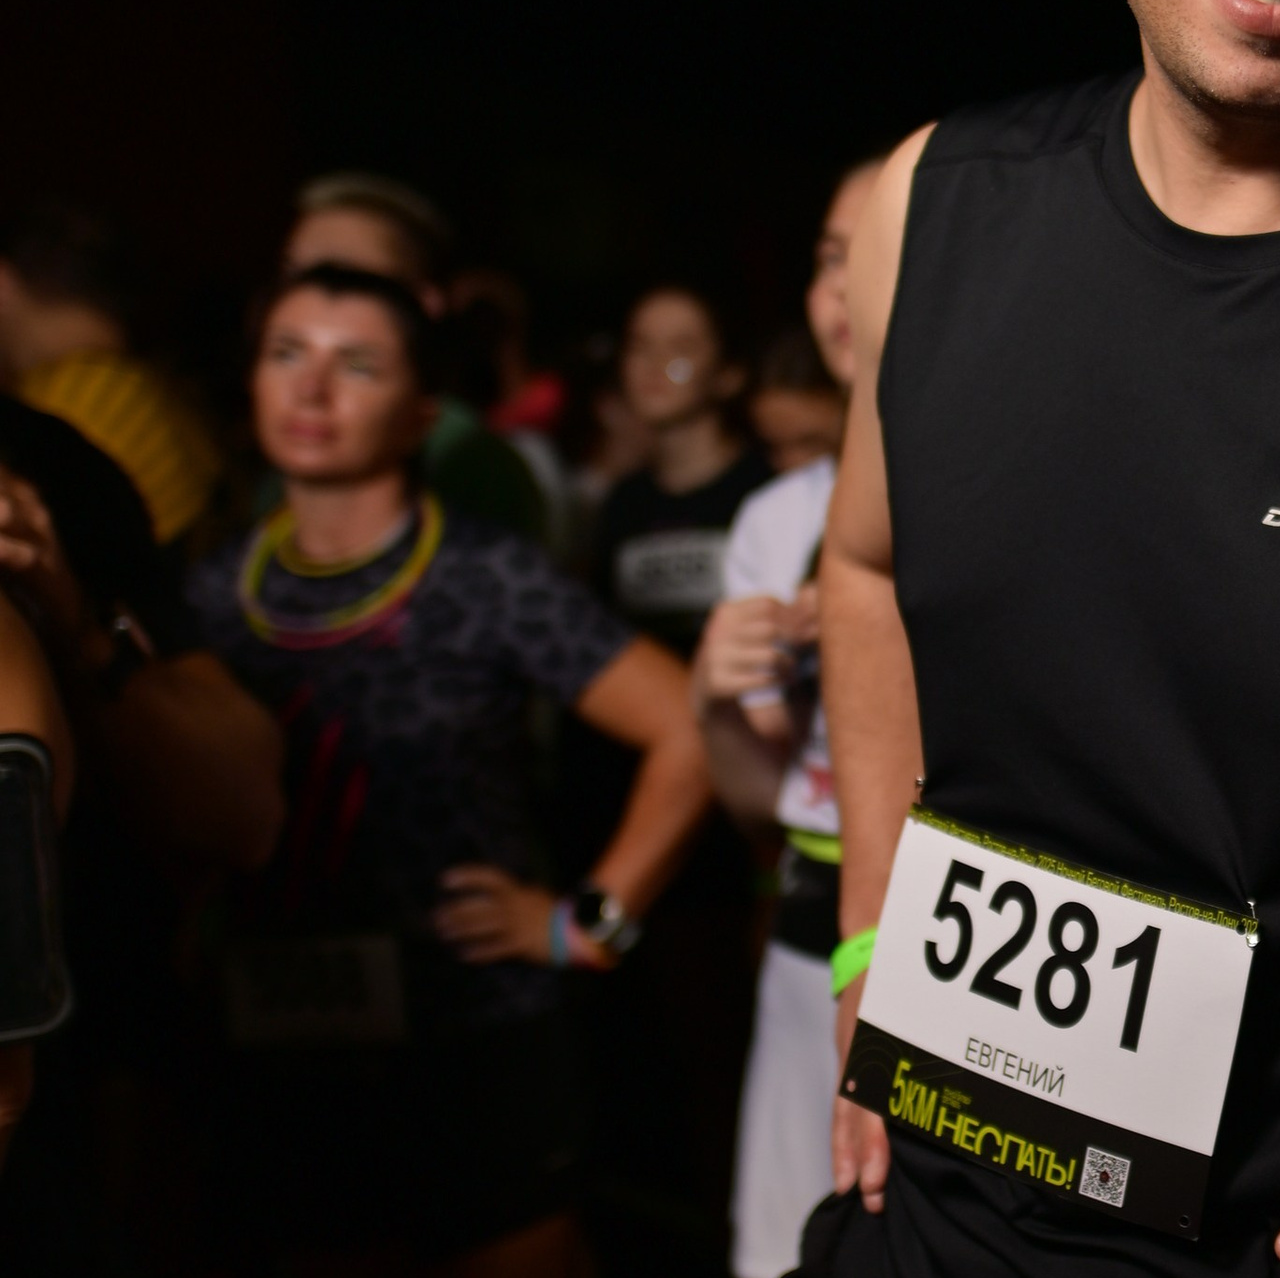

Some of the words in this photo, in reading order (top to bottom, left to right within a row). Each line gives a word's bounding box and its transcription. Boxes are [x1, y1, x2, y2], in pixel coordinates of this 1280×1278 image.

[924, 858, 1162, 1053] 5281
[889, 1059, 939, 1132] 5КМ
[965, 1037, 1066, 1098] ЕВГЕНИЙ
